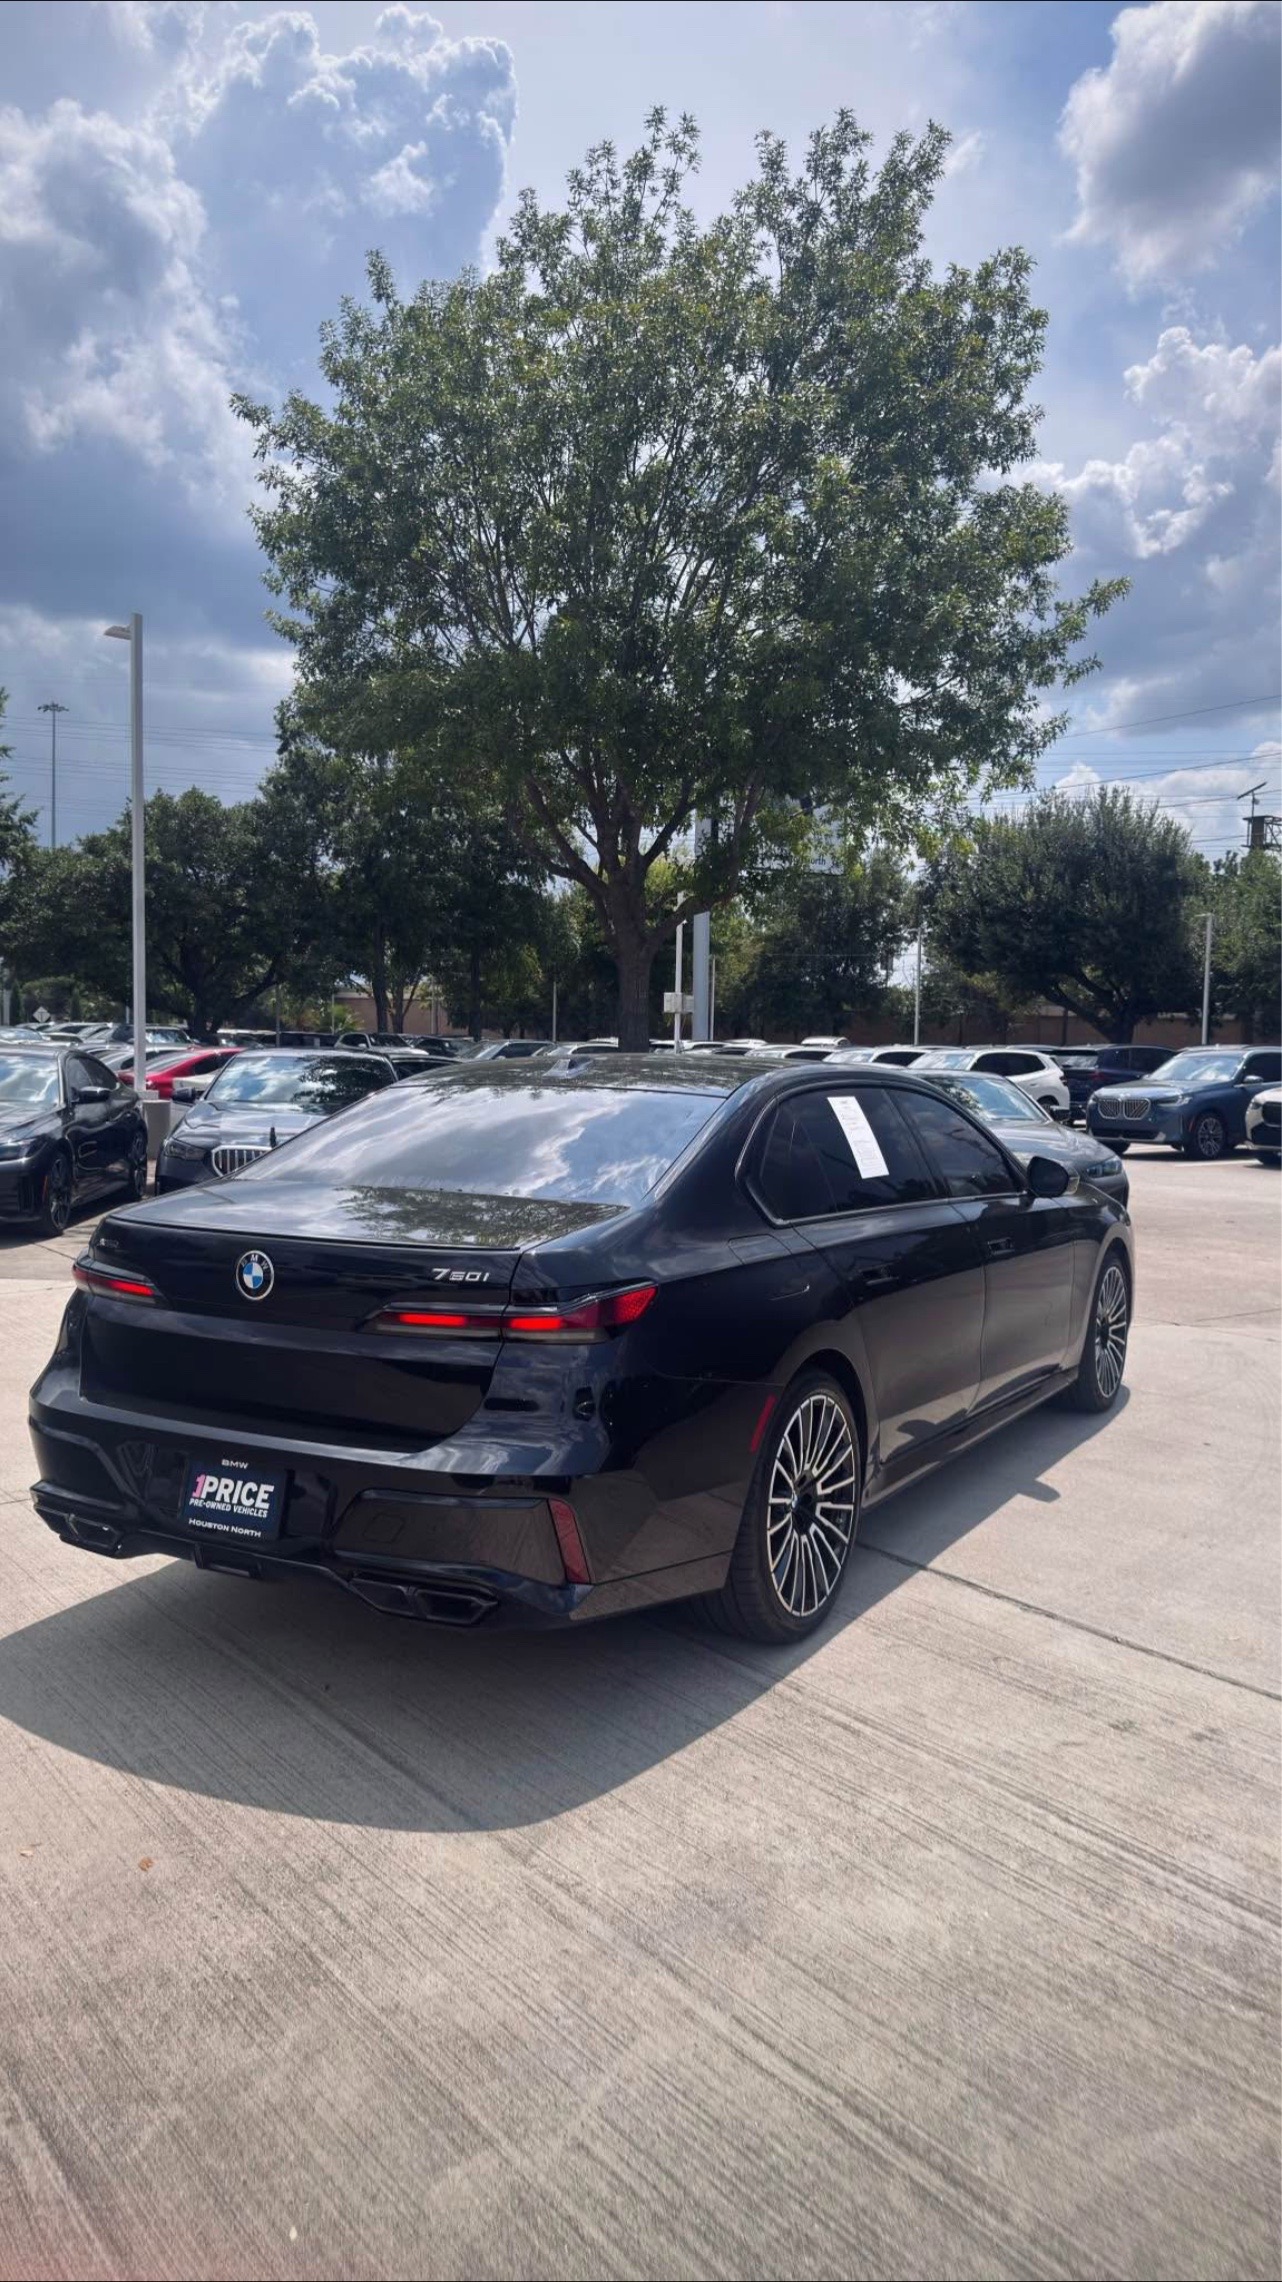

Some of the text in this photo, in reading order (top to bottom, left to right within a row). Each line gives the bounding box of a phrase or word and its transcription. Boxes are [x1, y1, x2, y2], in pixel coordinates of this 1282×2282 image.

[240, 1254, 269, 1270] BMW
[221, 1458, 248, 1469] BMW
[192, 1473, 275, 1509] 1PRICE
[189, 1498, 268, 1518] PRE-OWNED VEHICLES
[188, 1517, 262, 1538] HOUSTON NORTH
